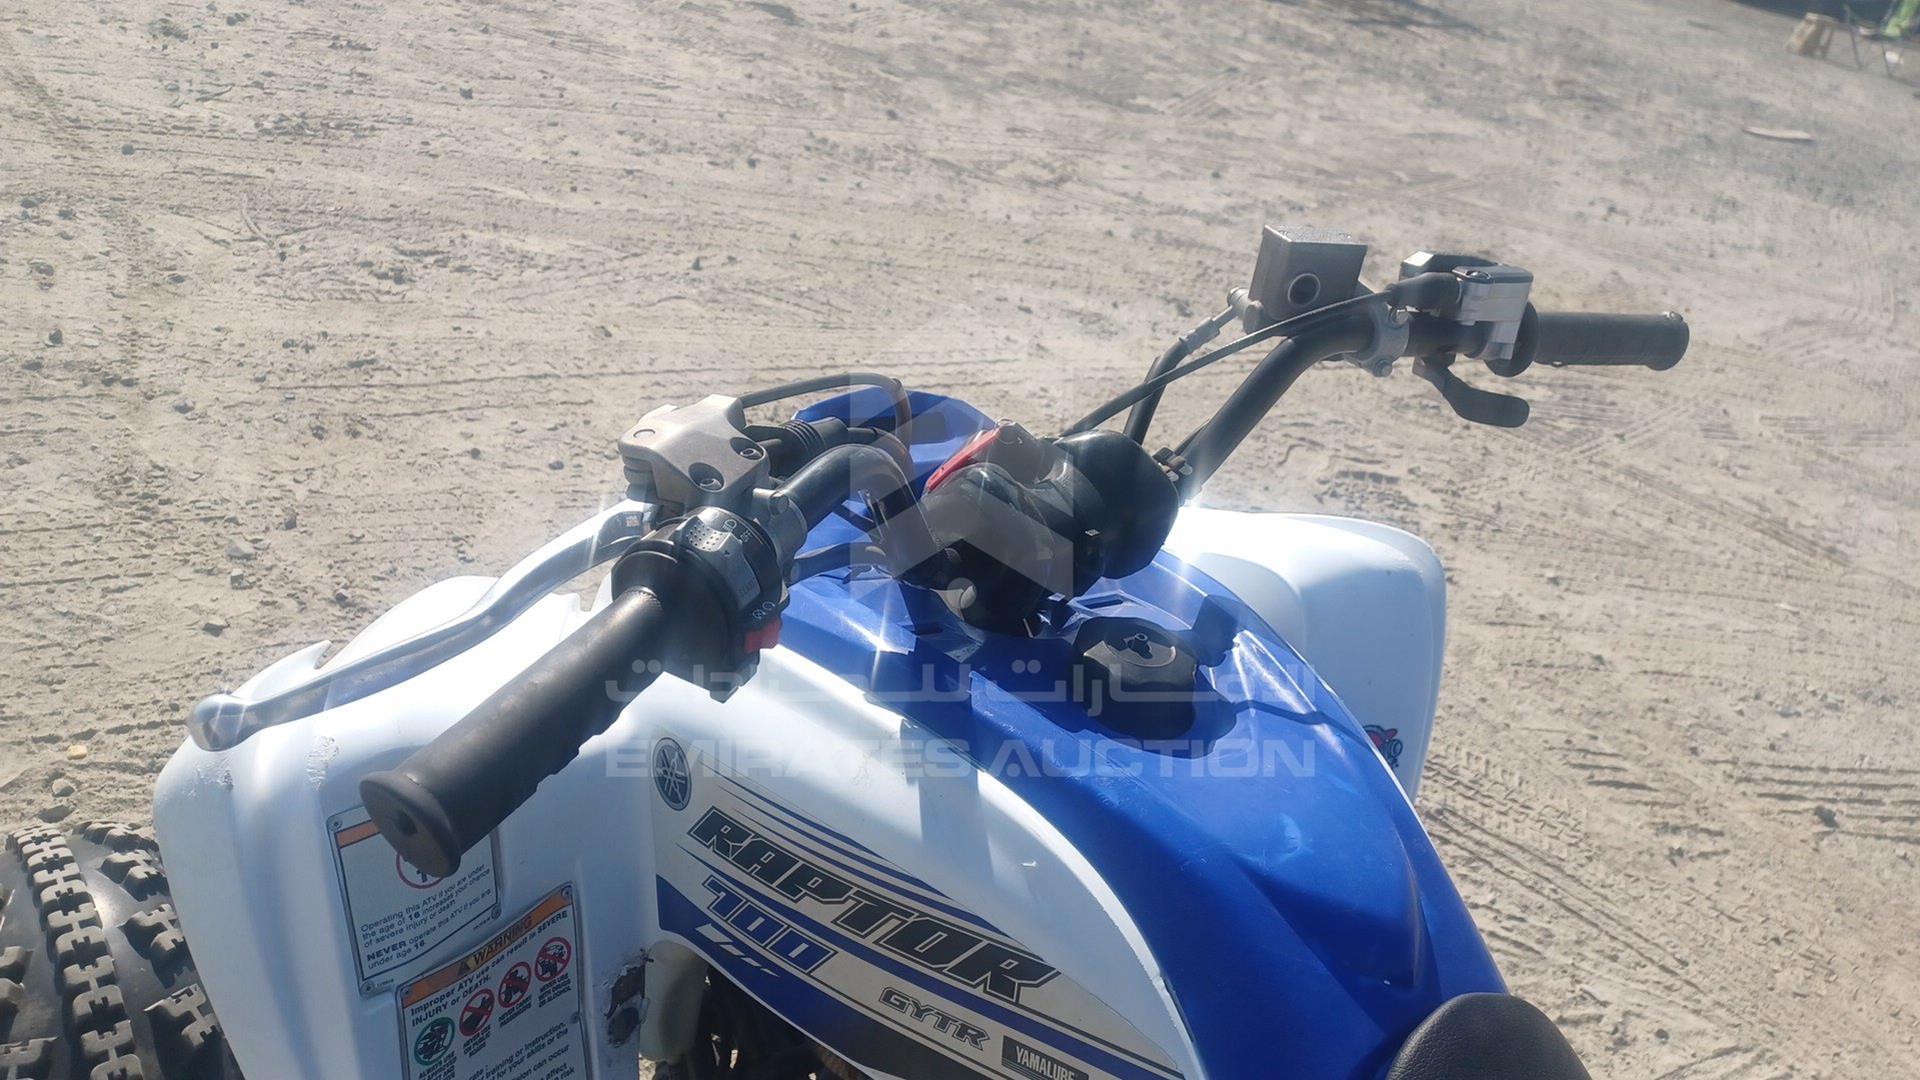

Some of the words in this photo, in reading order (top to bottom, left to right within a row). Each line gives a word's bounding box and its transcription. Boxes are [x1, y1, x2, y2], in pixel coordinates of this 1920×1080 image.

[361, 911, 403, 933] Operating
[405, 903, 421, 915] this
[422, 894, 437, 906] ATV
[443, 885, 456, 897] you
[362, 930, 376, 941] the
[379, 922, 395, 935] age
[397, 916, 407, 927] of
[408, 911, 421, 921] 16
[422, 894, 454, 915] increases
[686, 805, 1061, 1004] RAPTOR
[364, 938, 373, 948] of
[375, 928, 404, 944] severe
[406, 917, 428, 932] injury
[429, 911, 437, 920] or
[473, 915, 533, 965] WARNING
[701, 873, 840, 974] 700
[367, 940, 407, 961] NEVER
[409, 926, 437, 945] operate
[368, 955, 393, 970] under
[396, 948, 412, 960] age
[411, 990, 455, 1016] Improper
[458, 975, 474, 991] ATV
[491, 955, 505, 968] can
[507, 938, 528, 957] result
[537, 910, 568, 935] SEVERE
[412, 1003, 449, 1028] INJURY
[450, 995, 461, 1007] or
[877, 986, 989, 1051] GYTR
[485, 1055, 514, 1079] training
[515, 1047, 524, 1058] or
[508, 1056, 525, 1073] your
[533, 1059, 547, 1072] can
[548, 1043, 570, 1062] occur
[1015, 1045, 1076, 1080] YAMALUBE
